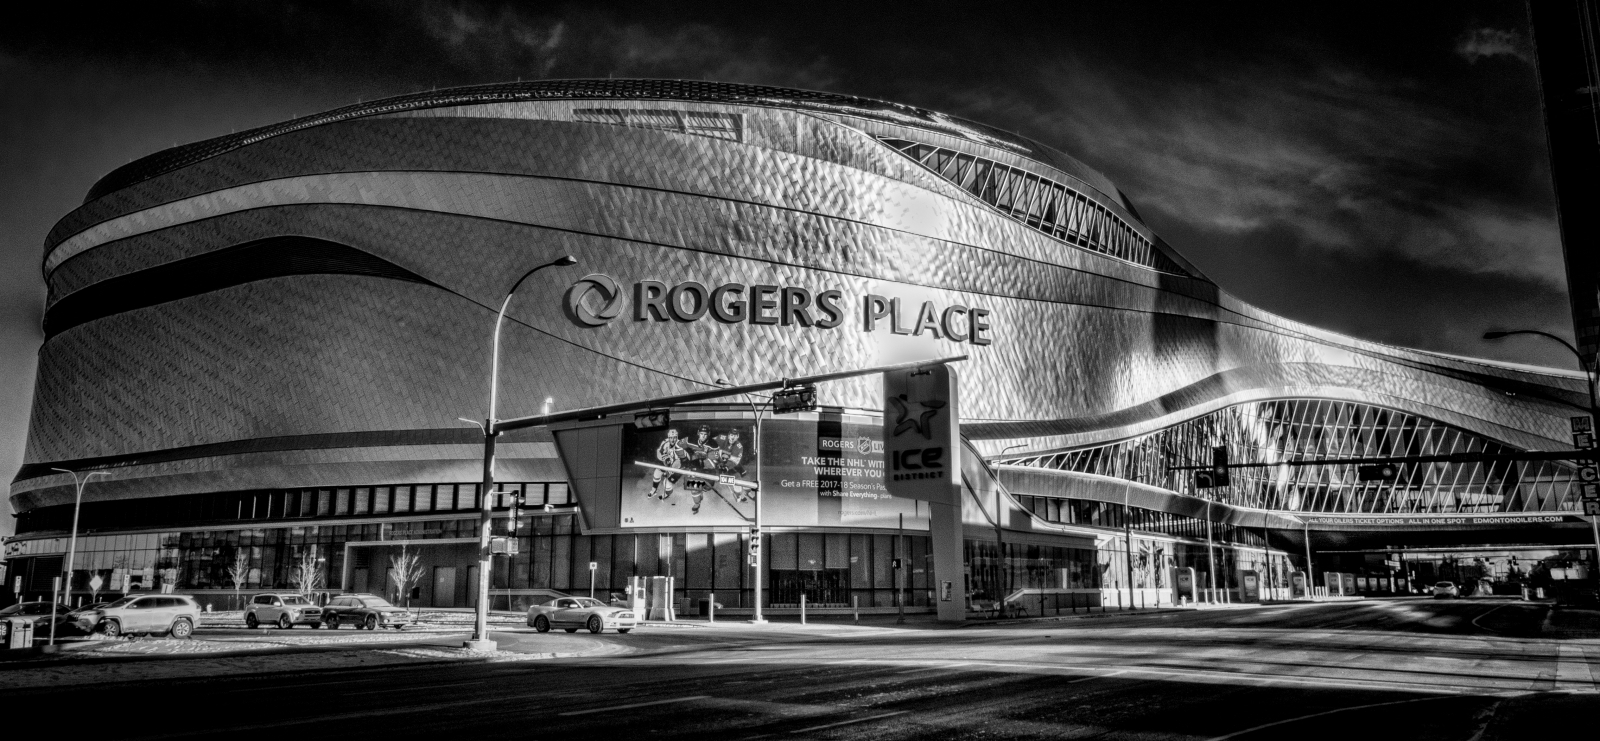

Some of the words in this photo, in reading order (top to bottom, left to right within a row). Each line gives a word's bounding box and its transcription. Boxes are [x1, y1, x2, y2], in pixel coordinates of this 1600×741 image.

[636, 280, 843, 328] ROGERS
[864, 294, 992, 345] PLACE
[822, 439, 854, 449] ROGERS
[801, 456, 826, 466] TAKE
[828, 457, 845, 466] THE
[893, 447, 943, 471] ICE
[1572, 417, 1600, 515] MECER
[813, 466, 862, 477] WHEREVER
[864, 469, 881, 478] YOU
[893, 471, 943, 481] DISTRICT
[780, 480, 795, 488] Get
[802, 480, 819, 488] FREE
[820, 480, 848, 489] 2017-18
[849, 482, 875, 490] Season's
[1473, 516, 1563, 524] EDMONTONOILERS.COM
